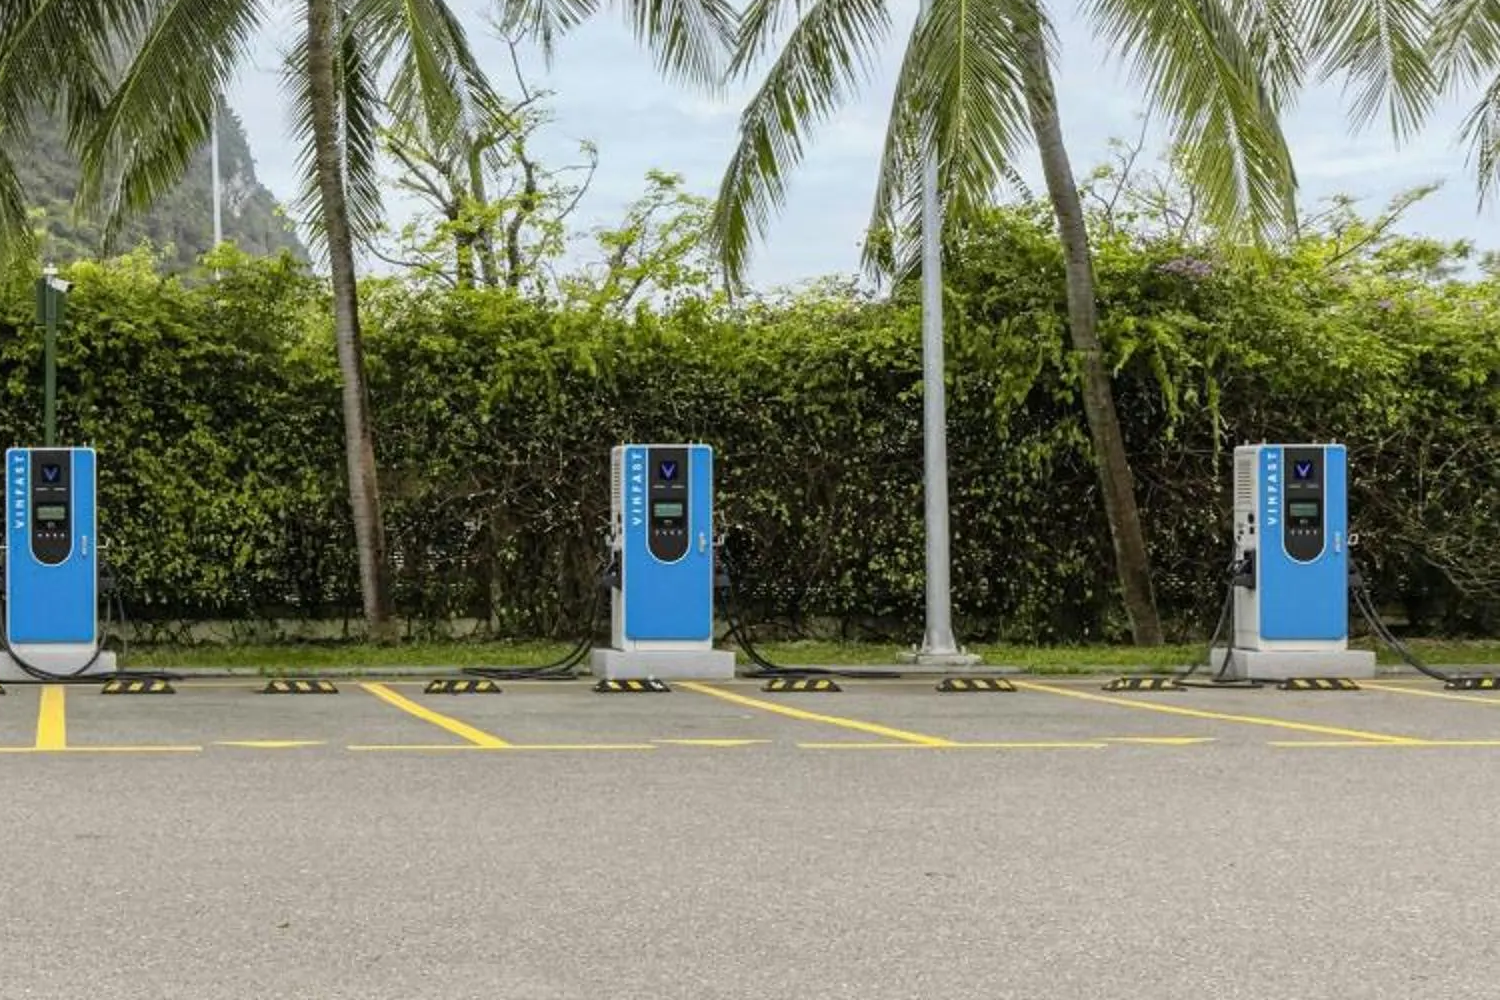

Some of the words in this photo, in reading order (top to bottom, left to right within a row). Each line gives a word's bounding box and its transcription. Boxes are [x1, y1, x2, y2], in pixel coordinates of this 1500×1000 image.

[14, 455, 25, 530] VINFAST
[631, 450, 643, 526] VINFAST
[1267, 451, 1278, 526] VINFAST
